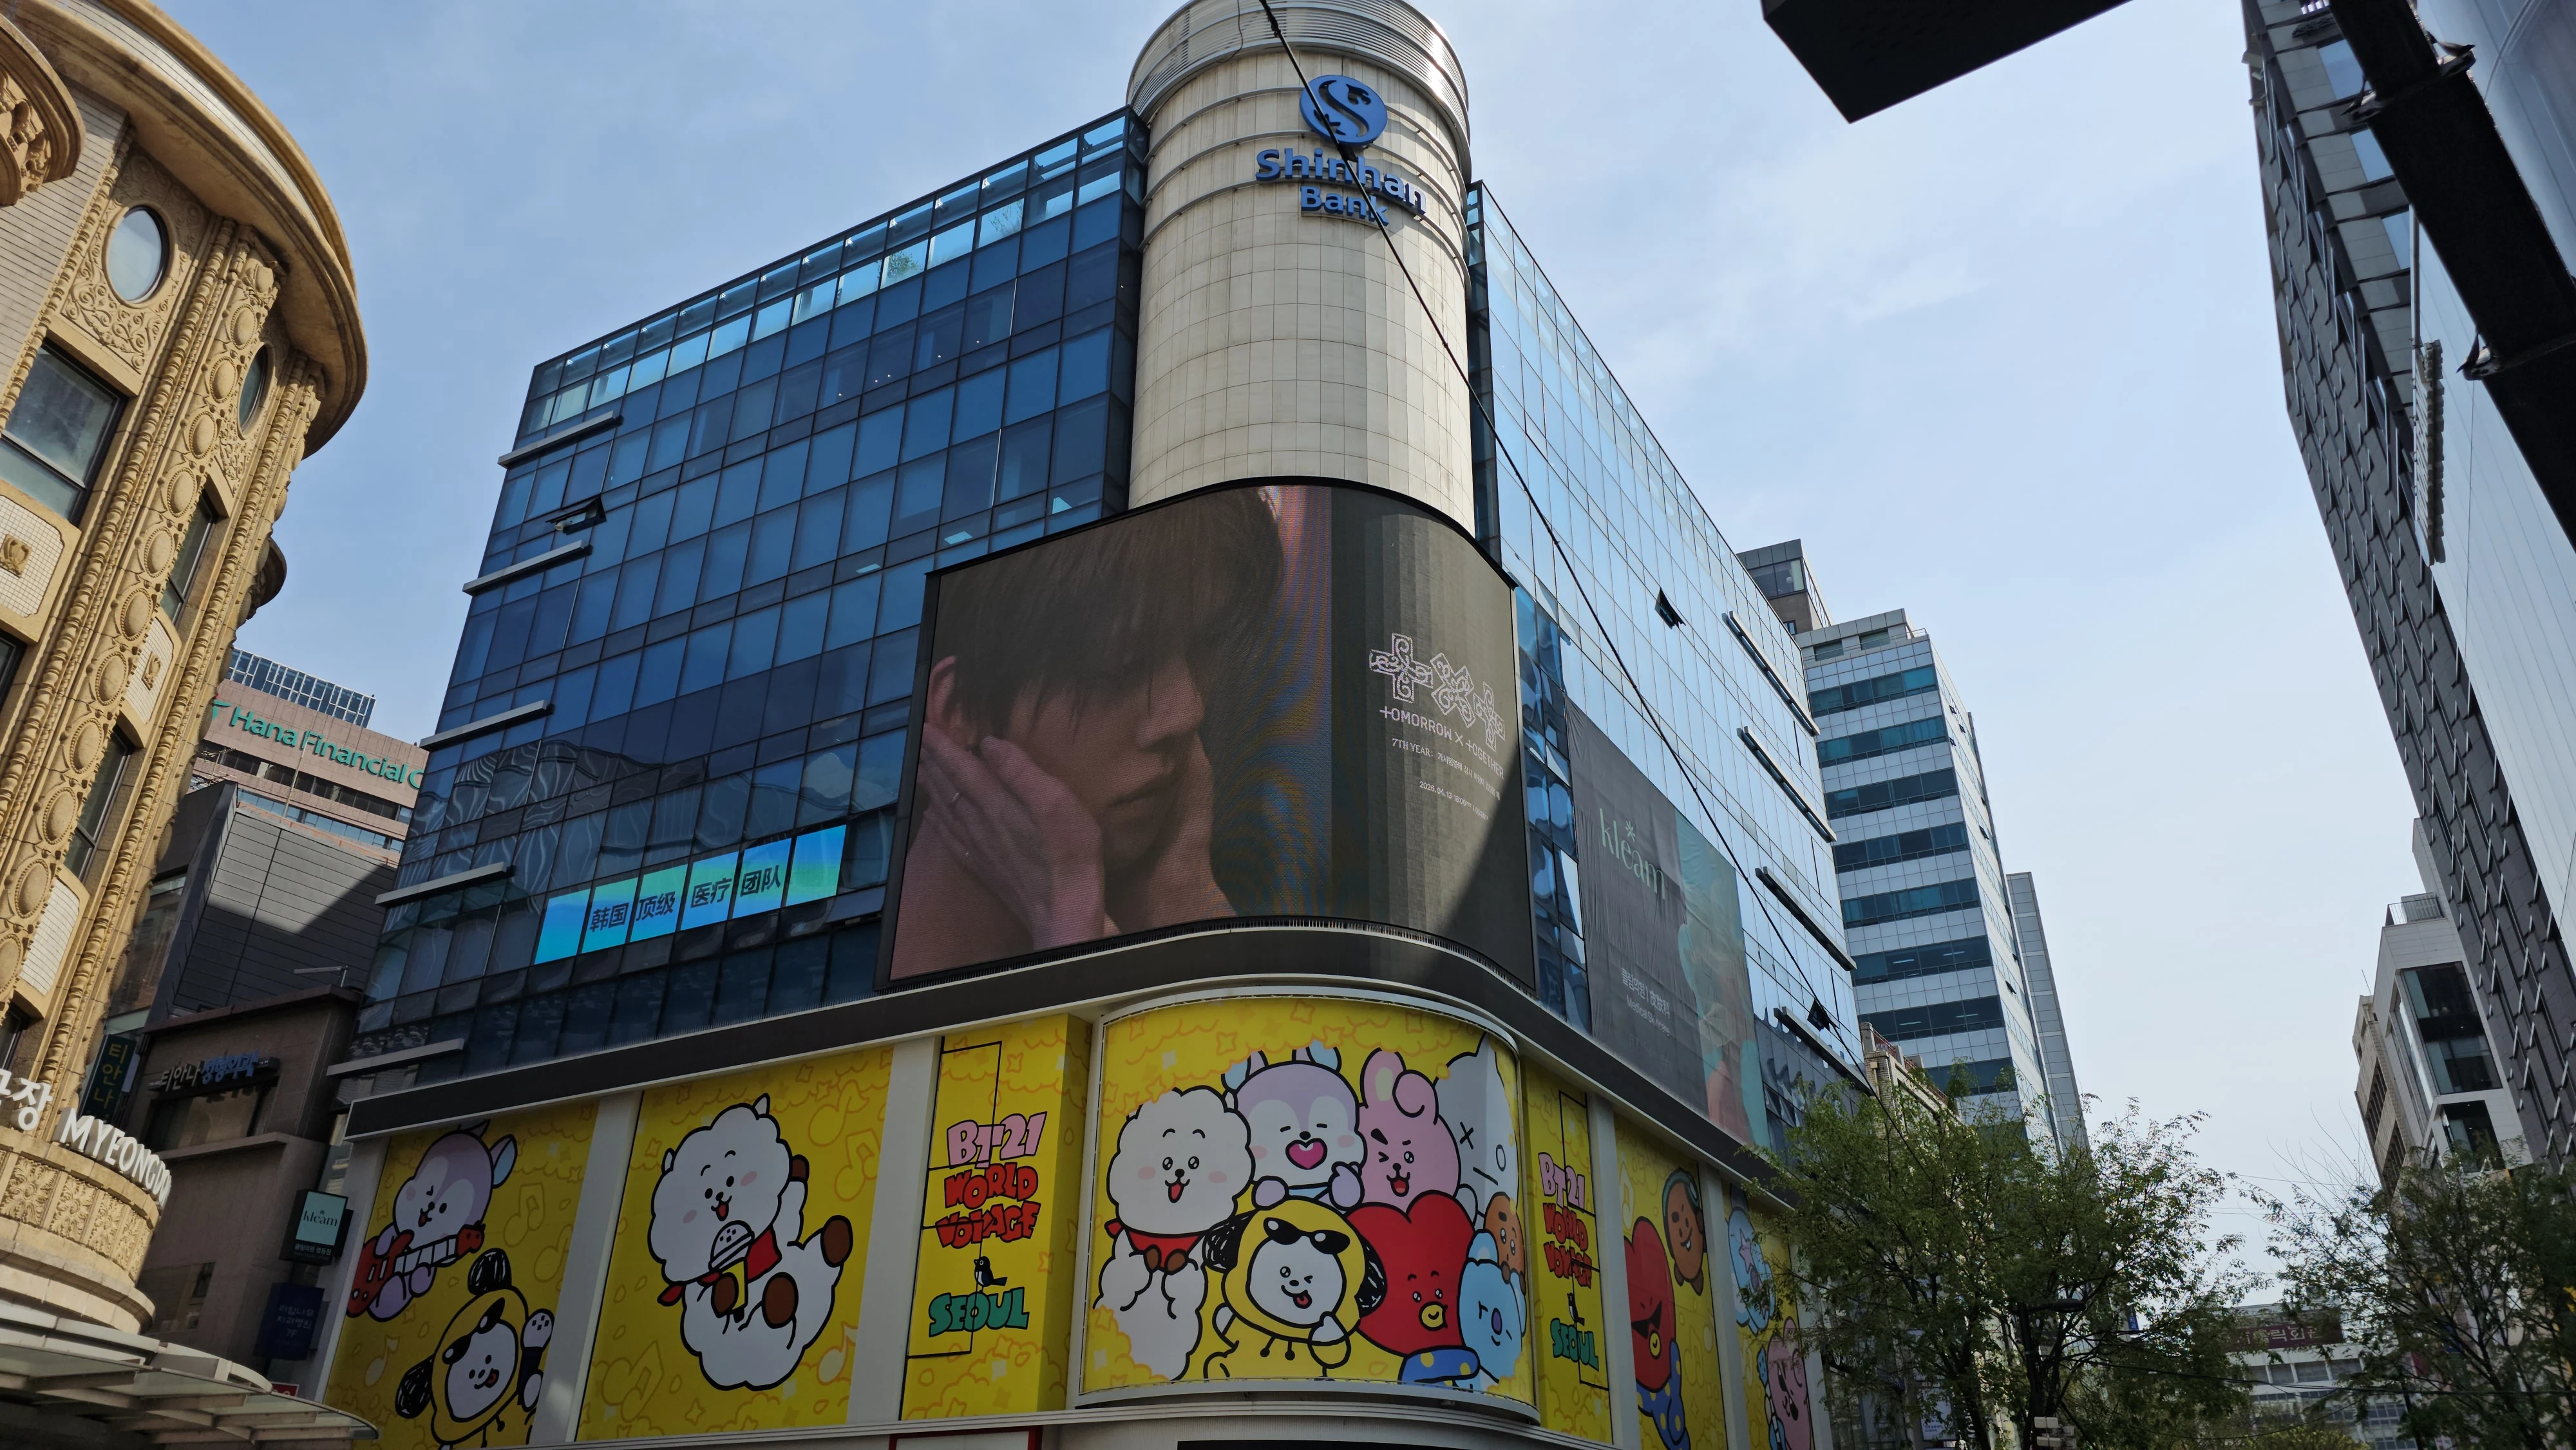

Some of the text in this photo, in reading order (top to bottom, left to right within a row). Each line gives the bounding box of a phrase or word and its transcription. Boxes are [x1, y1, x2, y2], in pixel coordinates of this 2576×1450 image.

[1256, 148, 1426, 215] Shinhan
[1300, 186, 1389, 226] Bank
[231, 706, 298, 748] Hana
[300, 730, 409, 783] Financial
[1392, 739, 1408, 750] 7TH
[1600, 807, 1665, 900] kleam
[946, 1111, 1048, 1169] BT21
[944, 1162, 1039, 1209] WORLD
[1538, 1152, 1586, 1213] BT21
[303, 1210, 337, 1227] kleam
[935, 1201, 1041, 1249] VOYAGE
[1542, 1203, 1589, 1252] WORLD
[1543, 1240, 1592, 1289] VOYAGE
[929, 1286, 1030, 1338] SEOUL
[1550, 1317, 1599, 1371] SEOUL
